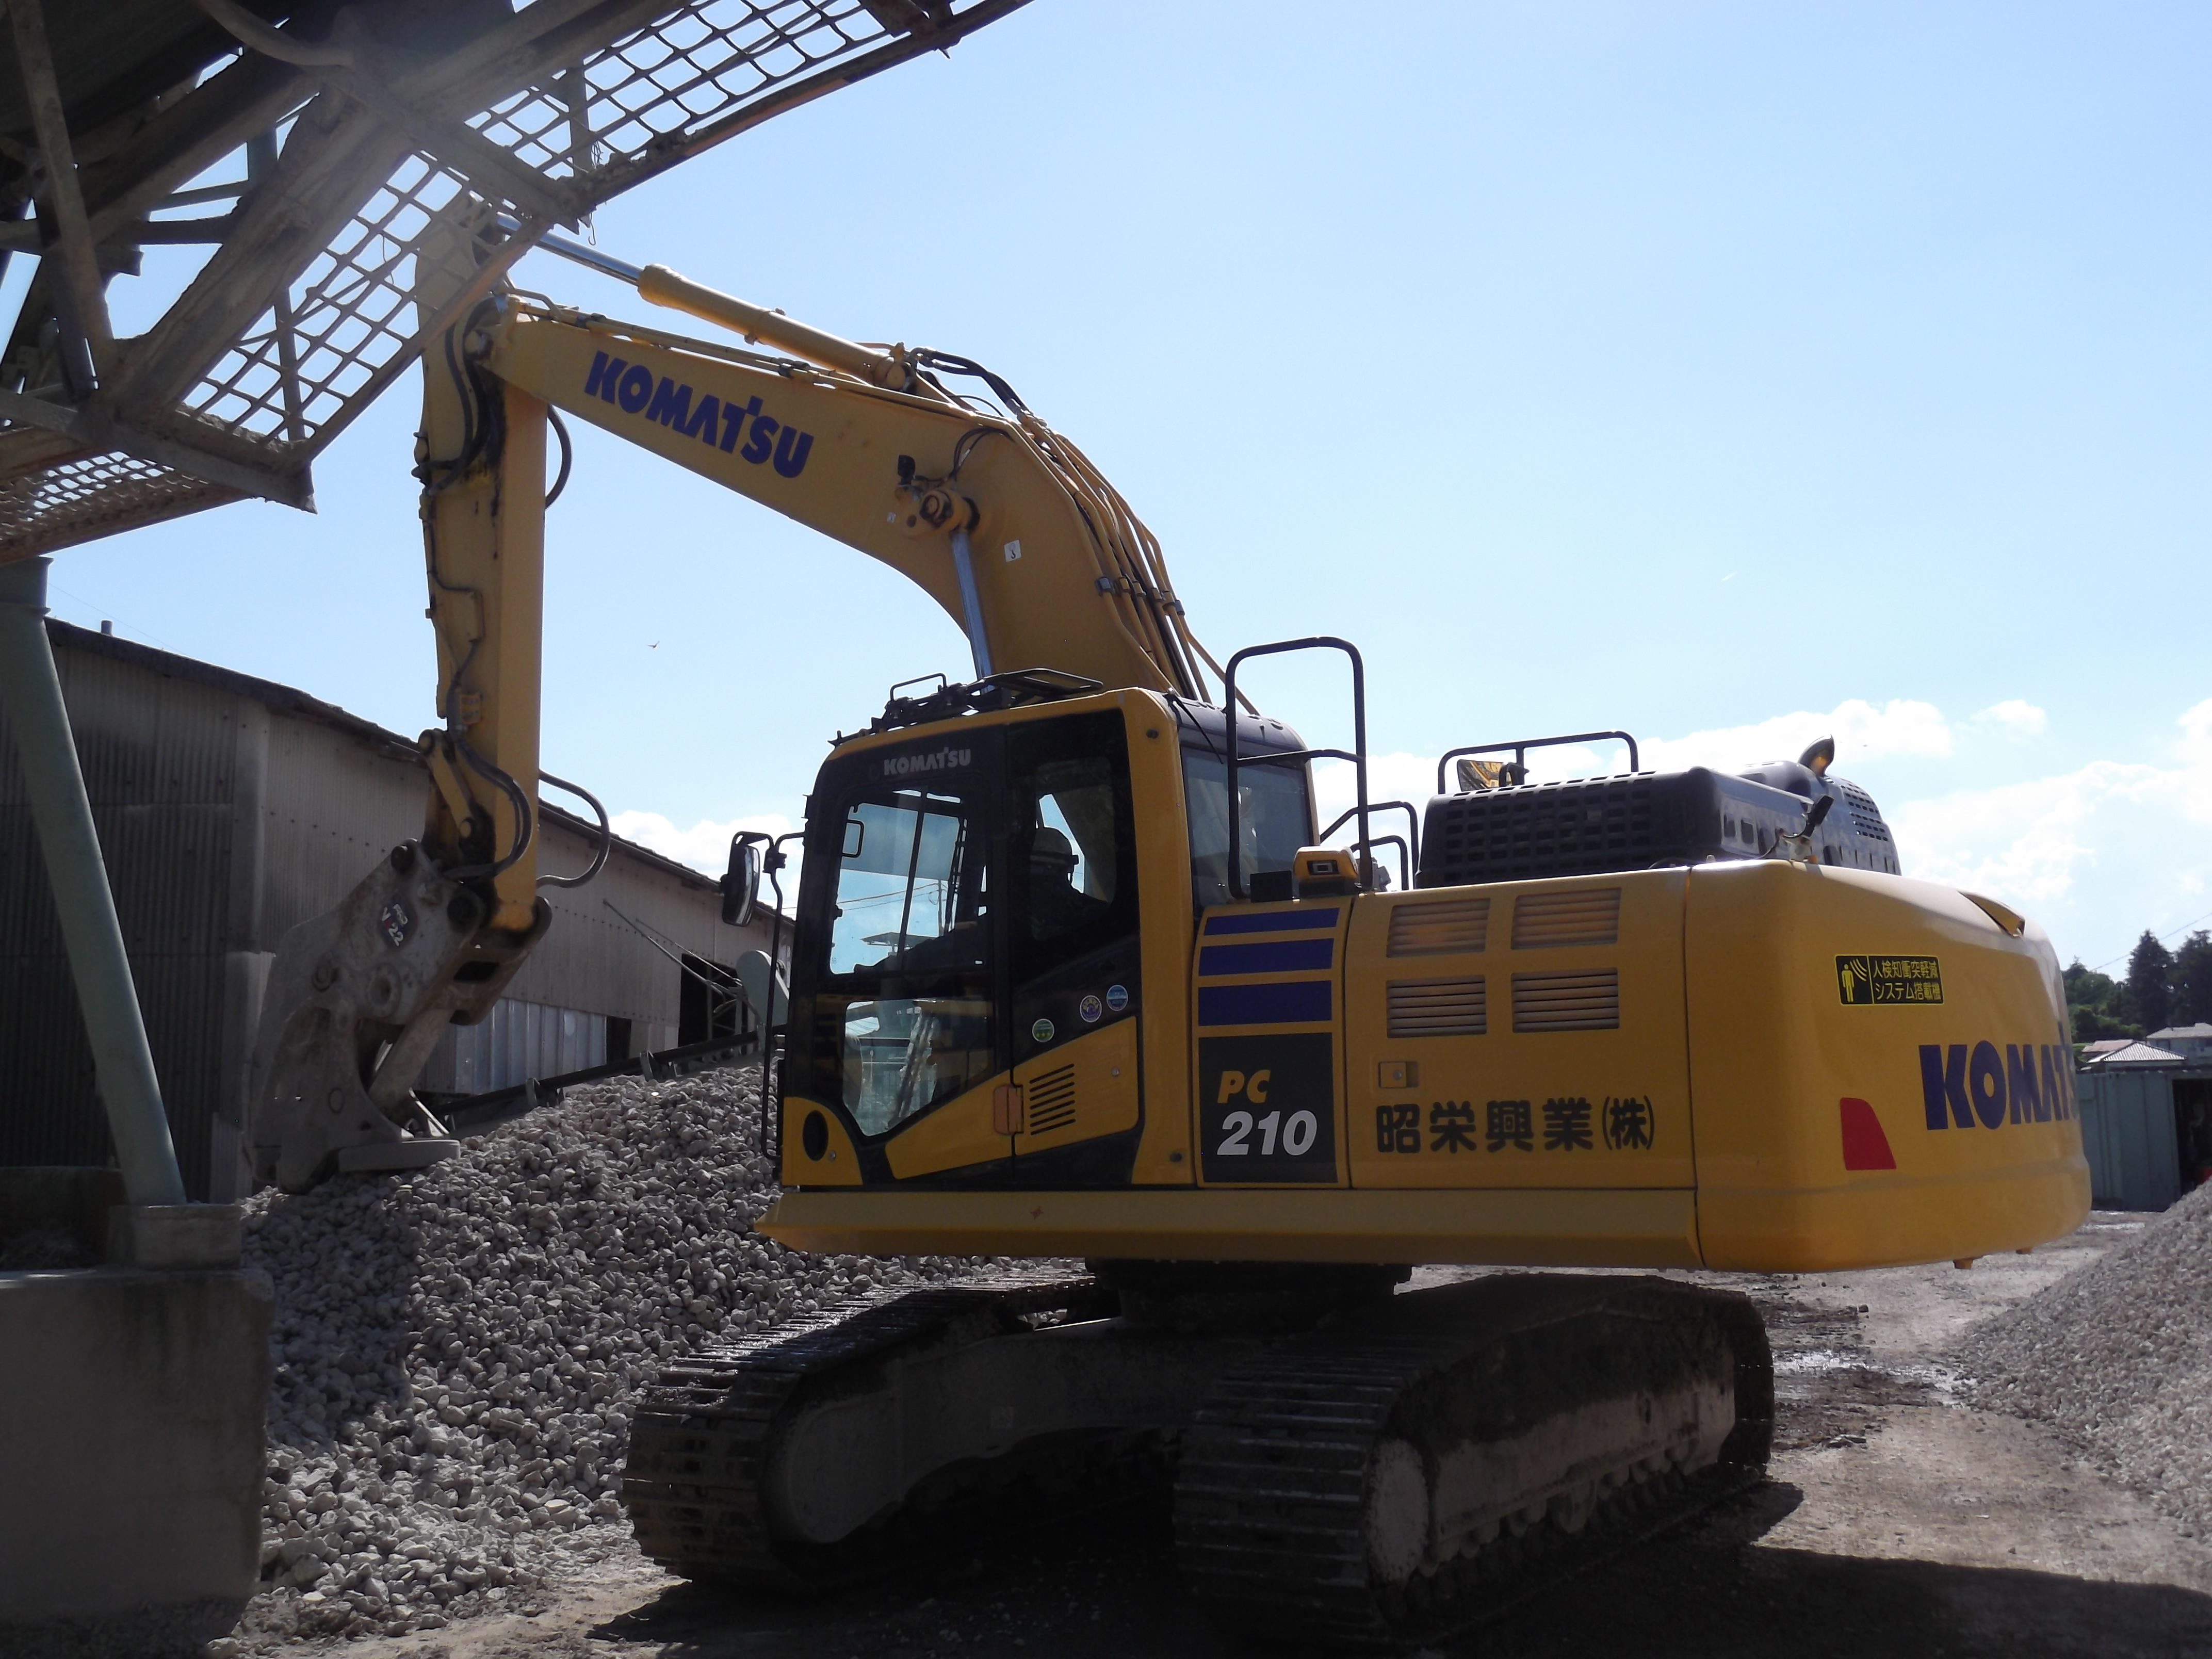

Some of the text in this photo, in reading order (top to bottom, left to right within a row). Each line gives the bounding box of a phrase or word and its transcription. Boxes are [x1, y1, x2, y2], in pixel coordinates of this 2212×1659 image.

[584, 351, 815, 478] KOMATSU
[884, 747, 971, 775] KOMATSU
[1217, 1069, 1271, 1103] PC
[1918, 1021, 2078, 1130] KOMAT
[1217, 1110, 1318, 1156] 210
